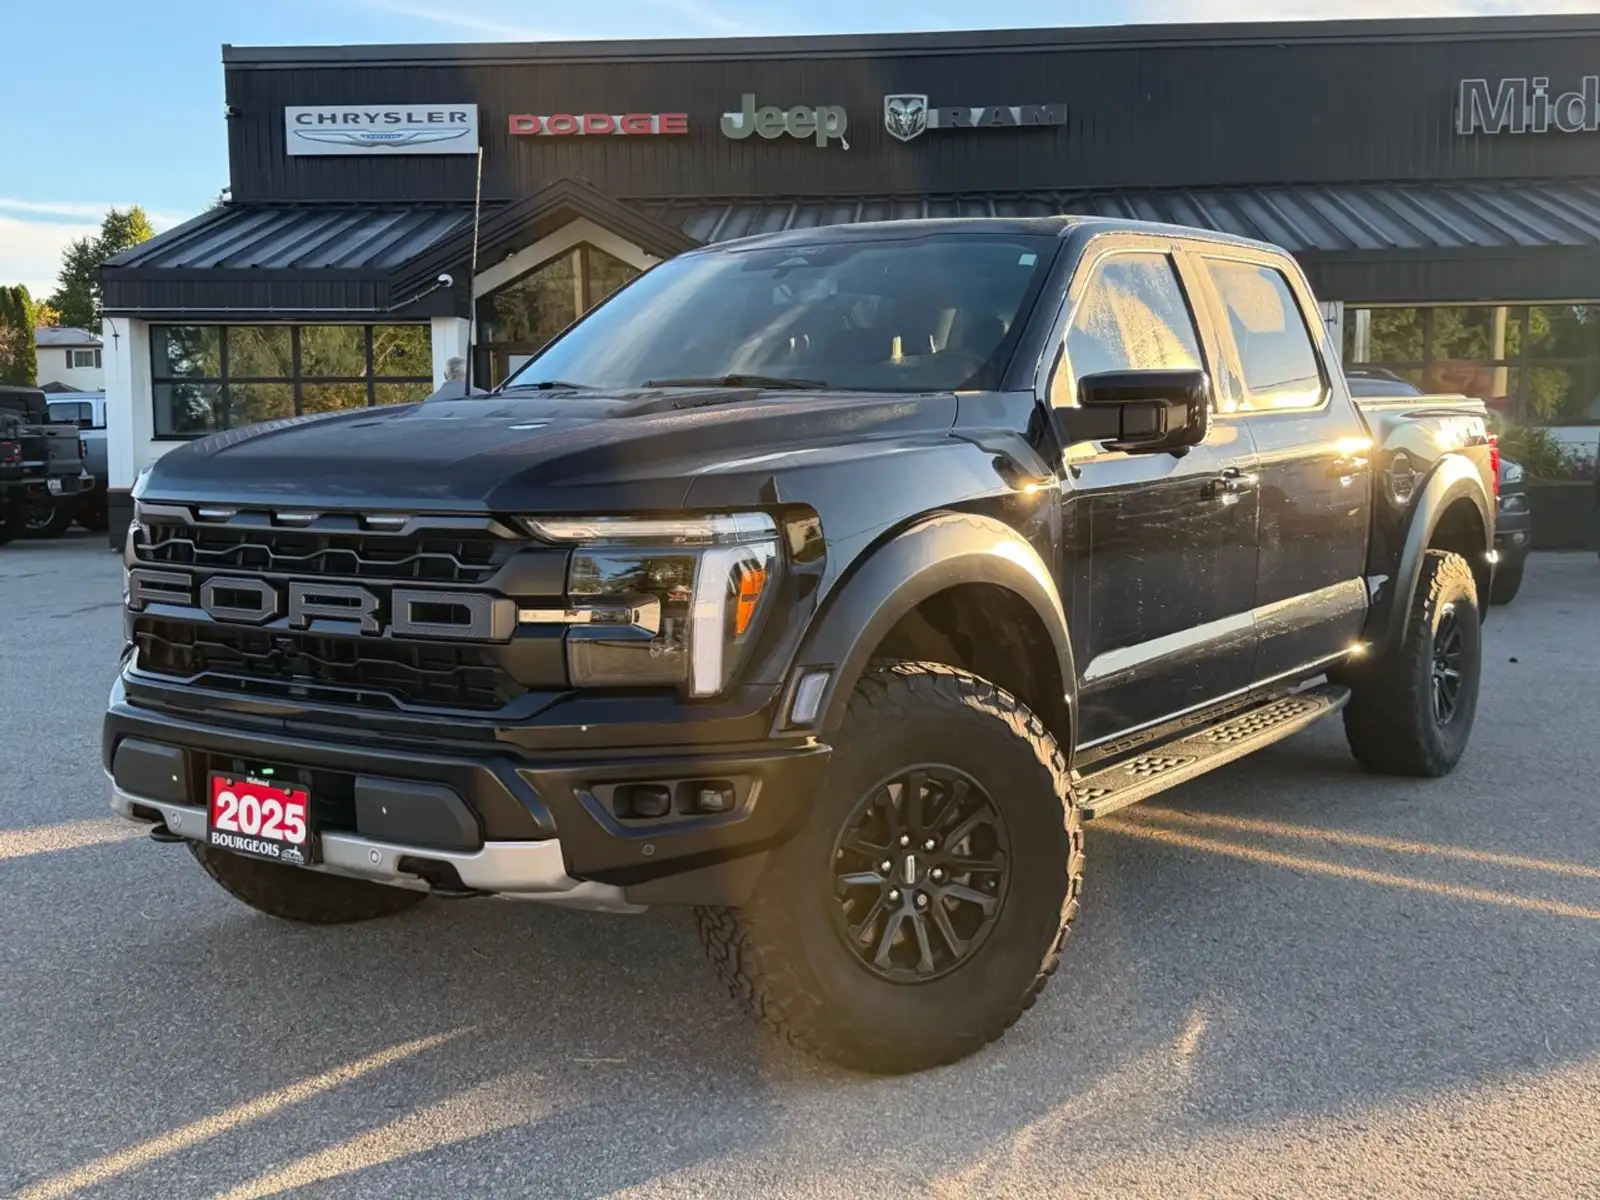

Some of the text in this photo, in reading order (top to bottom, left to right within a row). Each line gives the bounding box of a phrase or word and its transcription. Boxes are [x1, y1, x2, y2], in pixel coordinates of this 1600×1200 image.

[295, 110, 468, 125] CHRYSLER
[508, 113, 689, 136] DODGE
[720, 93, 848, 148] Jeep
[937, 103, 1068, 129] RAM
[1459, 75, 1599, 135] Mid
[128, 568, 516, 642] FORD
[216, 791, 307, 844] 2025
[211, 831, 280, 857] BOURGEOIS
